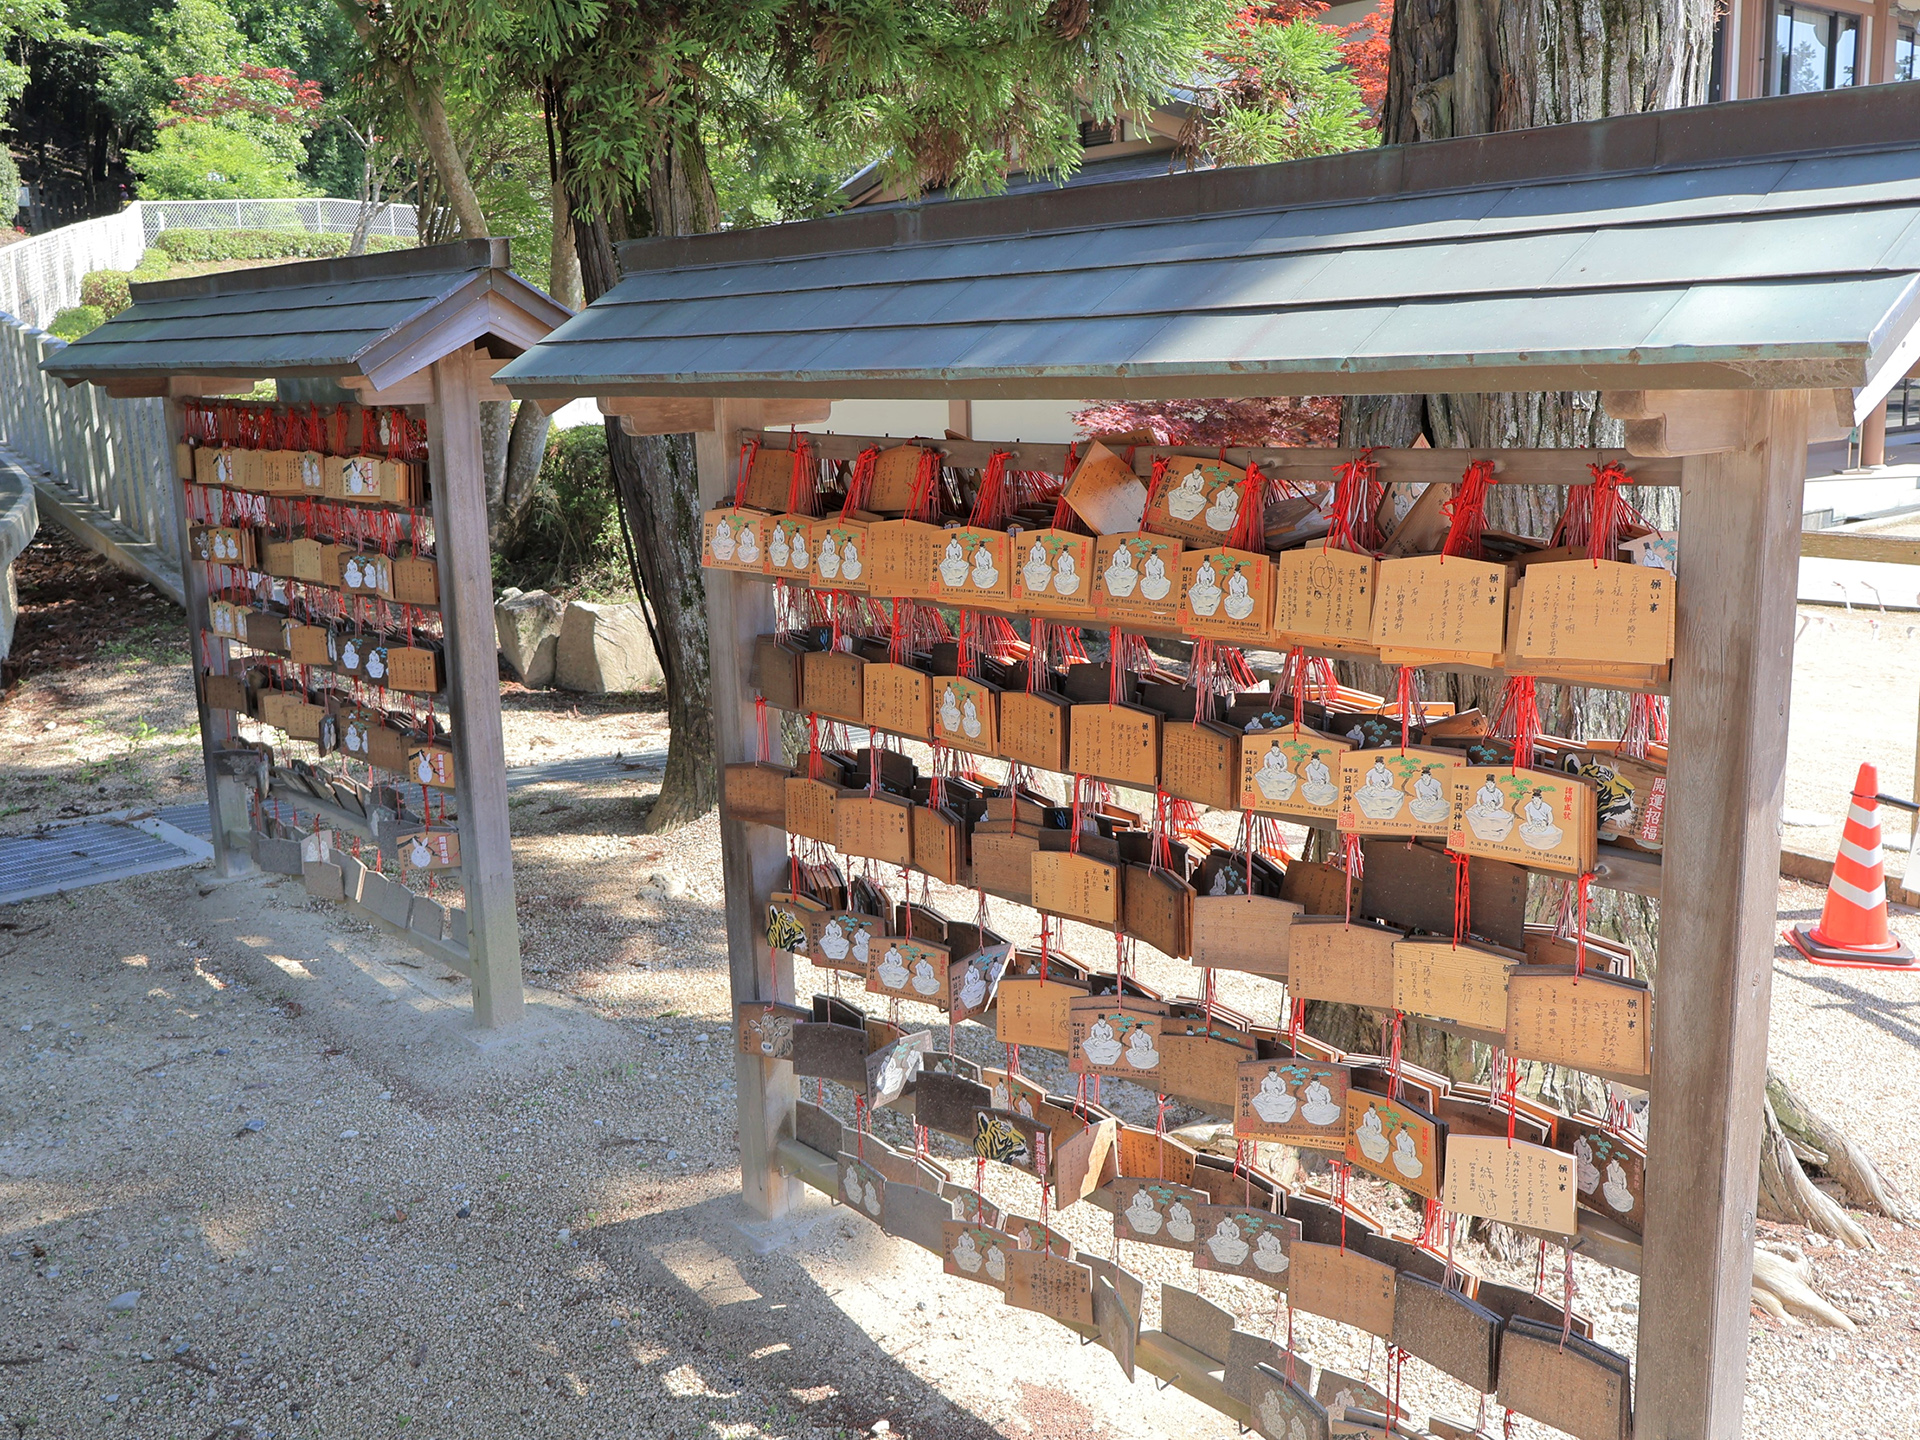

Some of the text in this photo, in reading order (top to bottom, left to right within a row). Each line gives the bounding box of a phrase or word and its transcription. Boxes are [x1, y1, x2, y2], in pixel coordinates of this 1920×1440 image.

[1155, 475, 1172, 508] 日岡神社
[1095, 557, 1103, 591] 日岡神社
[1359, 565, 1368, 596] 願い事
[1488, 573, 1499, 606] 願い事
[1180, 574, 1188, 610] 日岡神社
[1649, 578, 1662, 614] 願い事
[1141, 721, 1149, 748] 願い事
[1244, 757, 1253, 793] 日岡神社
[1342, 776, 1352, 813] 日岡神社
[1563, 786, 1573, 820] 諸願成就
[1641, 777, 1668, 841] 開運招福
[1452, 792, 1463, 832] 日岡神社
[1478, 965, 1492, 1022] 志望校に
[1626, 998, 1638, 1030] 願い事
[1072, 1028, 1080, 1059] 日岡神社
[1241, 1083, 1250, 1118] 日岡神社
[1347, 1112, 1355, 1146] 日岡神社
[1035, 1131, 1047, 1175] 開運招福
[1558, 1164, 1568, 1192] 願い事
